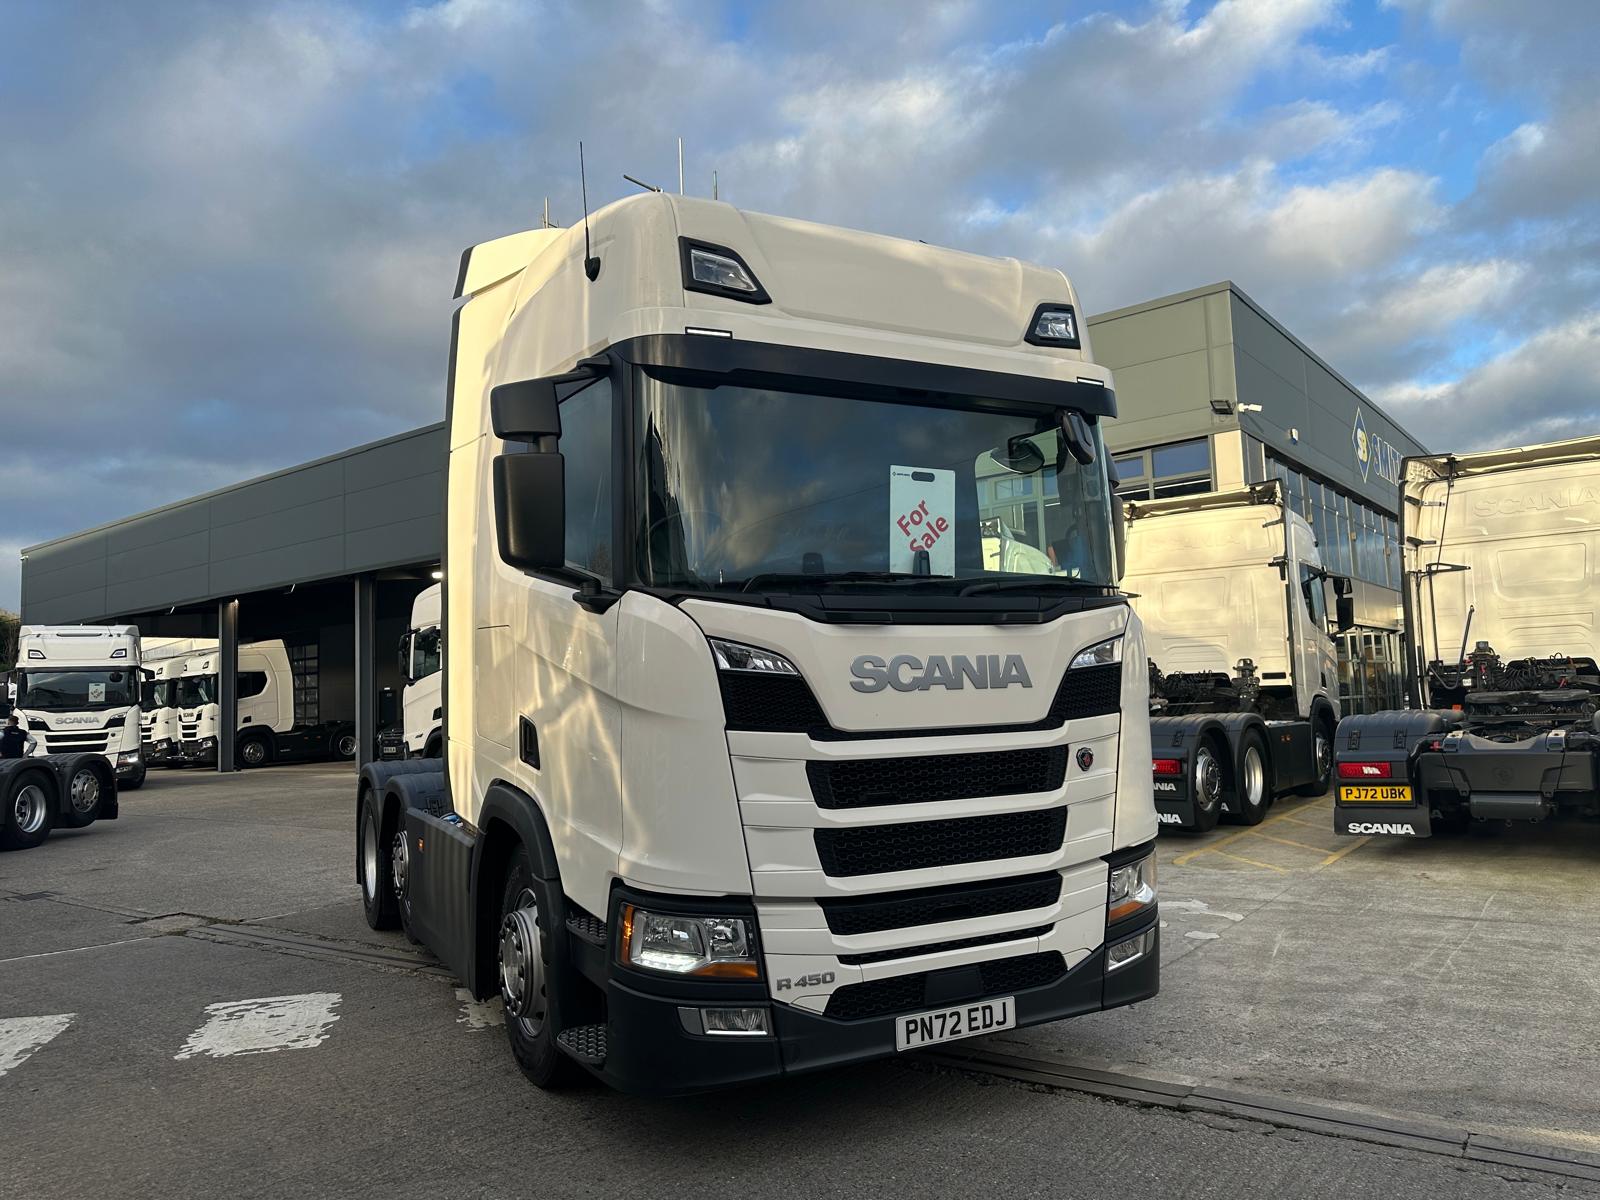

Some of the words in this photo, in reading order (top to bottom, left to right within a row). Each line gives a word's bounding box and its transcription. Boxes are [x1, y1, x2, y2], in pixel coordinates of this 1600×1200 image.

[1372, 433, 1402, 487] SMIT
[896, 499, 929, 537] For
[909, 516, 949, 552] Sale
[850, 655, 1033, 694] SCANIA
[55, 716, 100, 725] SCANIA
[1345, 788, 1378, 799] PJ72
[1381, 788, 1406, 799] UBK
[1157, 813, 1182, 824] NIA
[1347, 822, 1416, 835] SCANIA
[776, 977, 792, 992] R
[794, 971, 836, 988] 450
[905, 1011, 962, 1045] PN72
[967, 1001, 1007, 1033] EDJ
